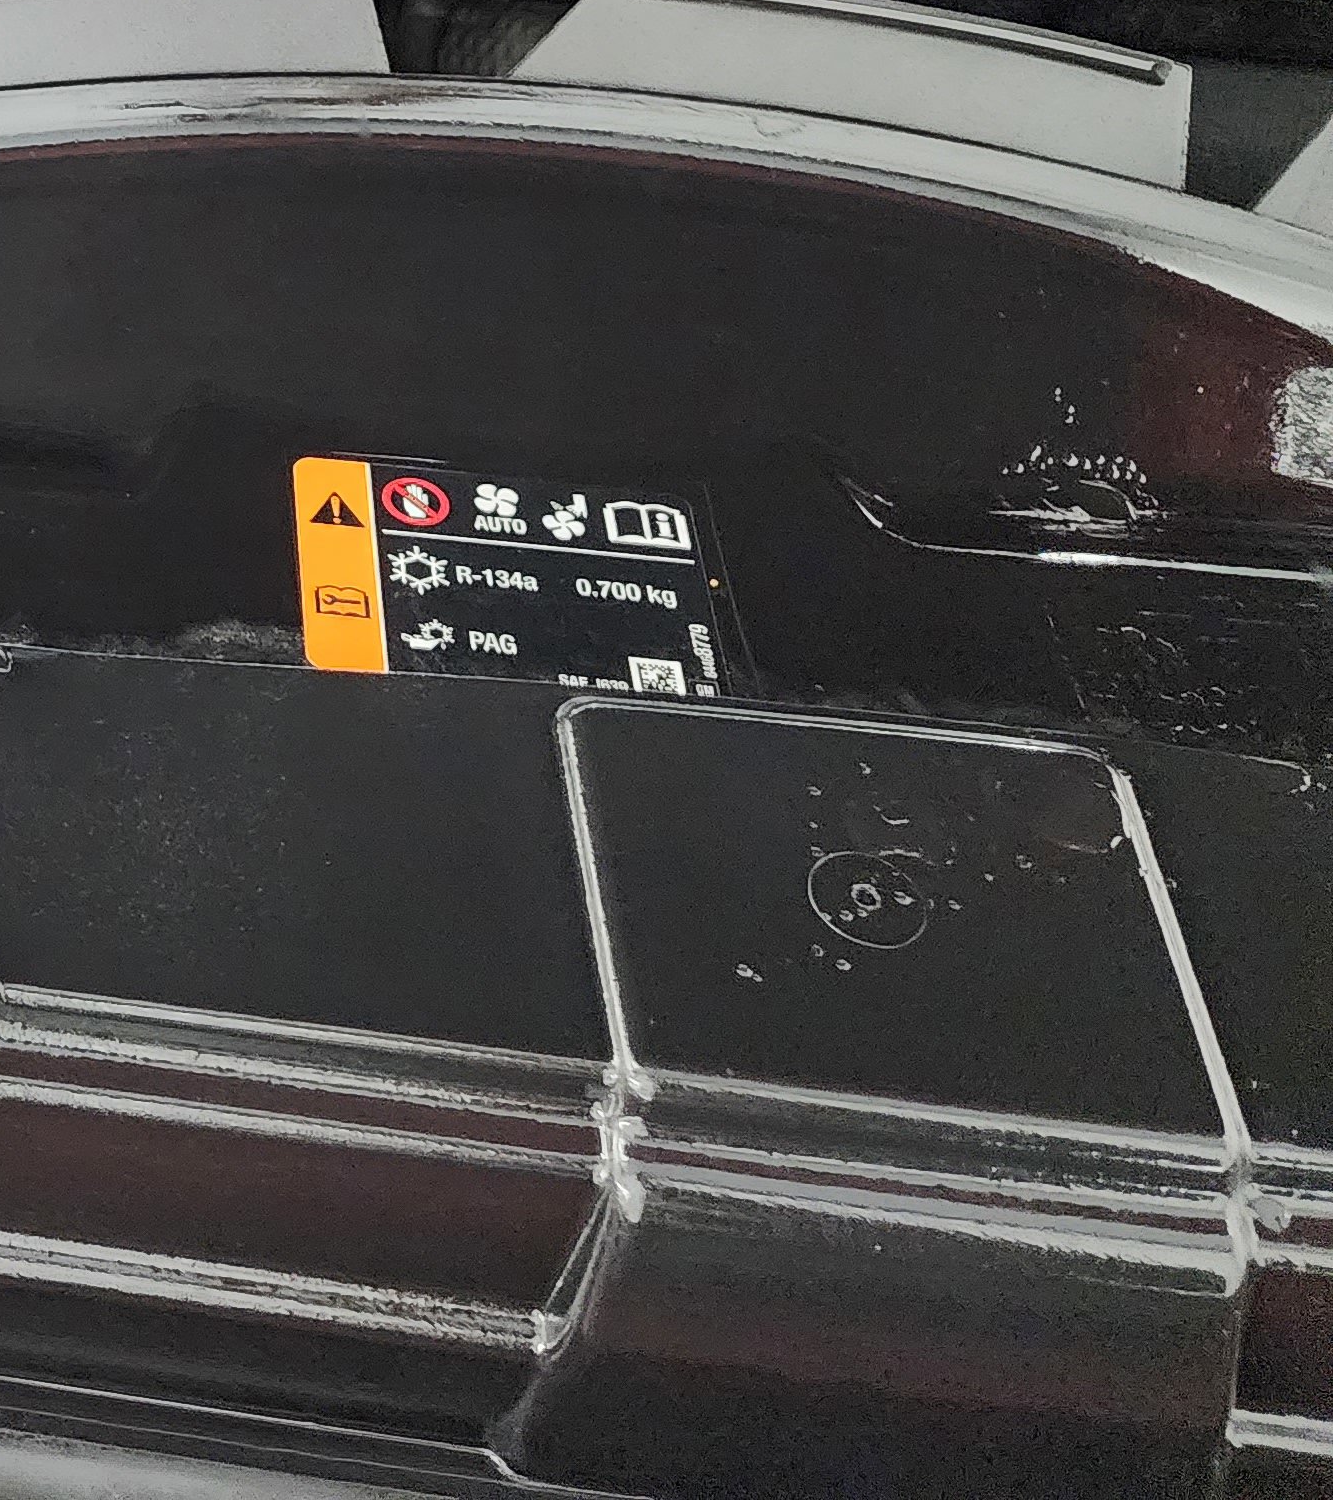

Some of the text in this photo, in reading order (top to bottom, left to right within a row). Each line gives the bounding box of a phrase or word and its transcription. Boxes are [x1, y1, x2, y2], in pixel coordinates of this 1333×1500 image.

[473, 515, 528, 535] AUTO
[455, 565, 678, 609] R-134a 0.700 kg
[468, 630, 518, 655] PAG
